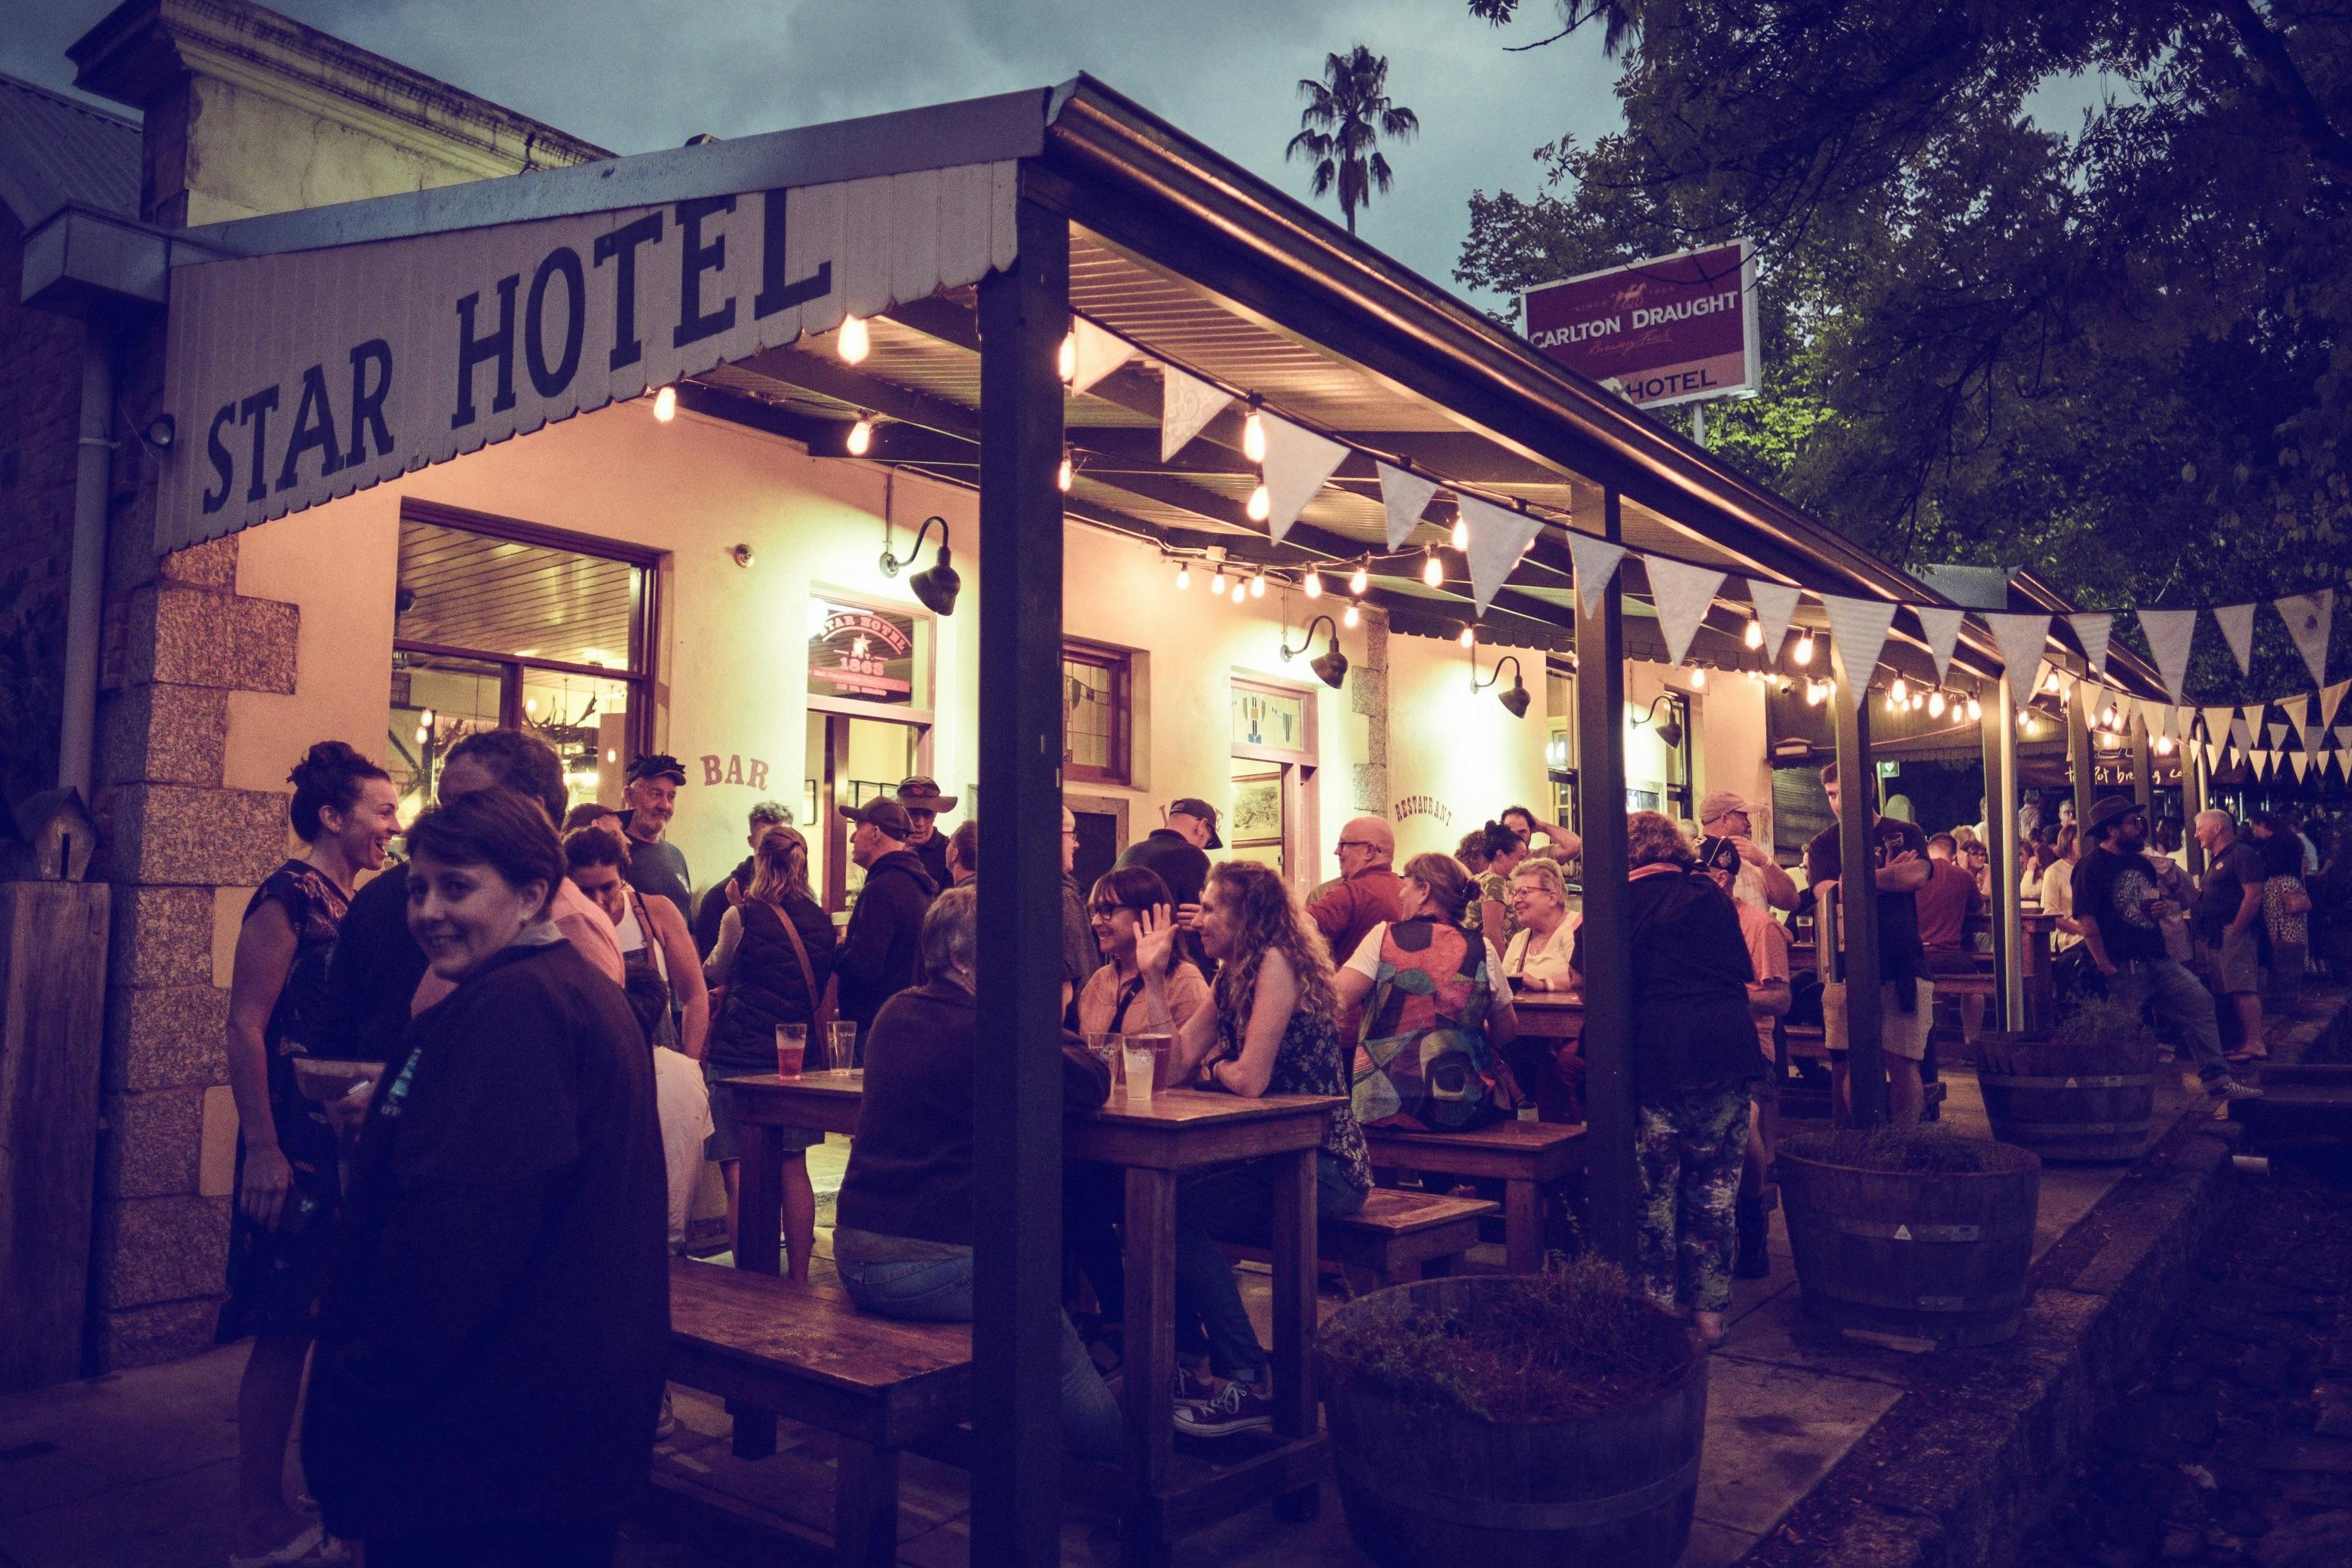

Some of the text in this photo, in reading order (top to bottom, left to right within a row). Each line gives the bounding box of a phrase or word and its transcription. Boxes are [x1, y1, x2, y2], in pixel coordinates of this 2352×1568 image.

[1530, 291, 1738, 349] CARLTON DRAUGHT
[203, 188, 831, 515] STAR HOTEL
[1626, 369, 1717, 399] HOTEL
[700, 755, 769, 792] BAR
[1395, 796, 1453, 826] RESTAURANT
